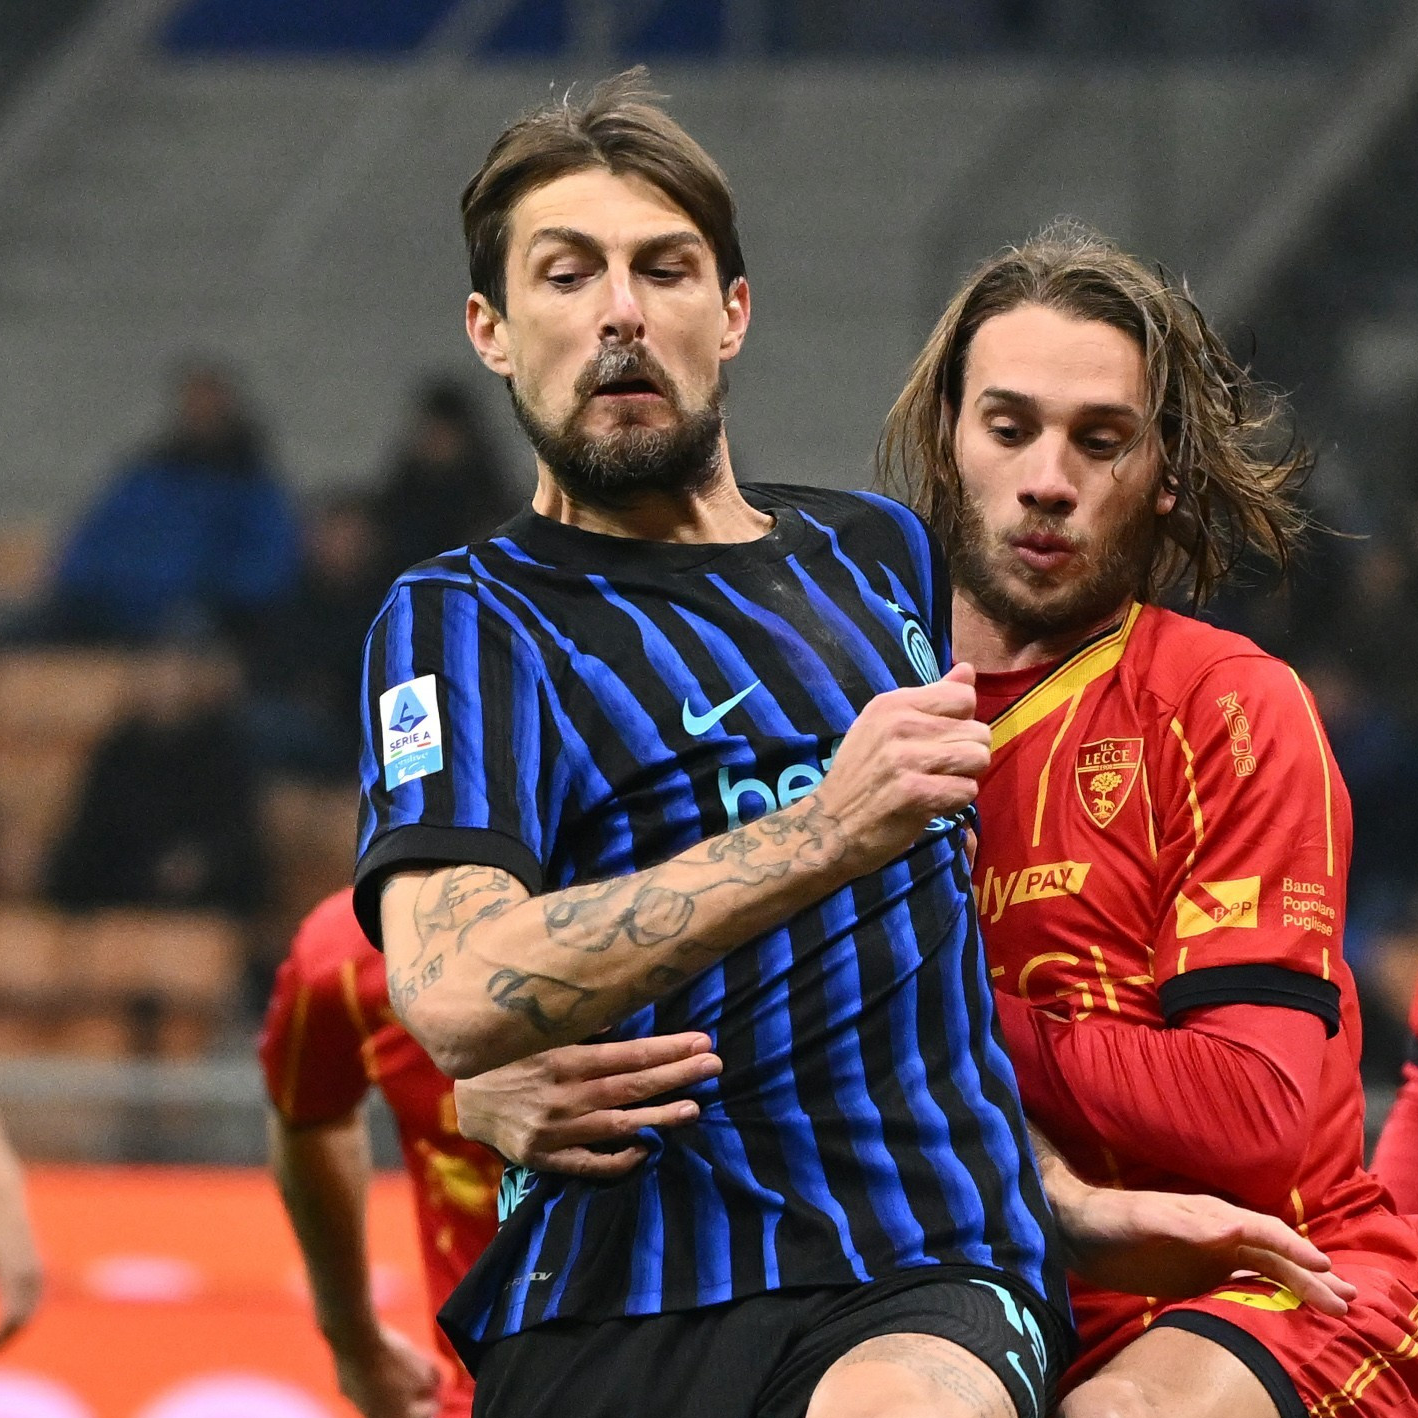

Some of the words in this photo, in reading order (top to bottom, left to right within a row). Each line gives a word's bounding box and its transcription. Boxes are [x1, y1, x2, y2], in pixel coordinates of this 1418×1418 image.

[389, 732, 420, 753] SERIE
[423, 730, 432, 741] A
[1085, 749, 1131, 766] LECCE
[1024, 867, 1074, 895] PAY
[1282, 877, 1326, 896] Banca
[1282, 896, 1336, 920] Popolare
[1282, 914, 1334, 937] Pugliese
